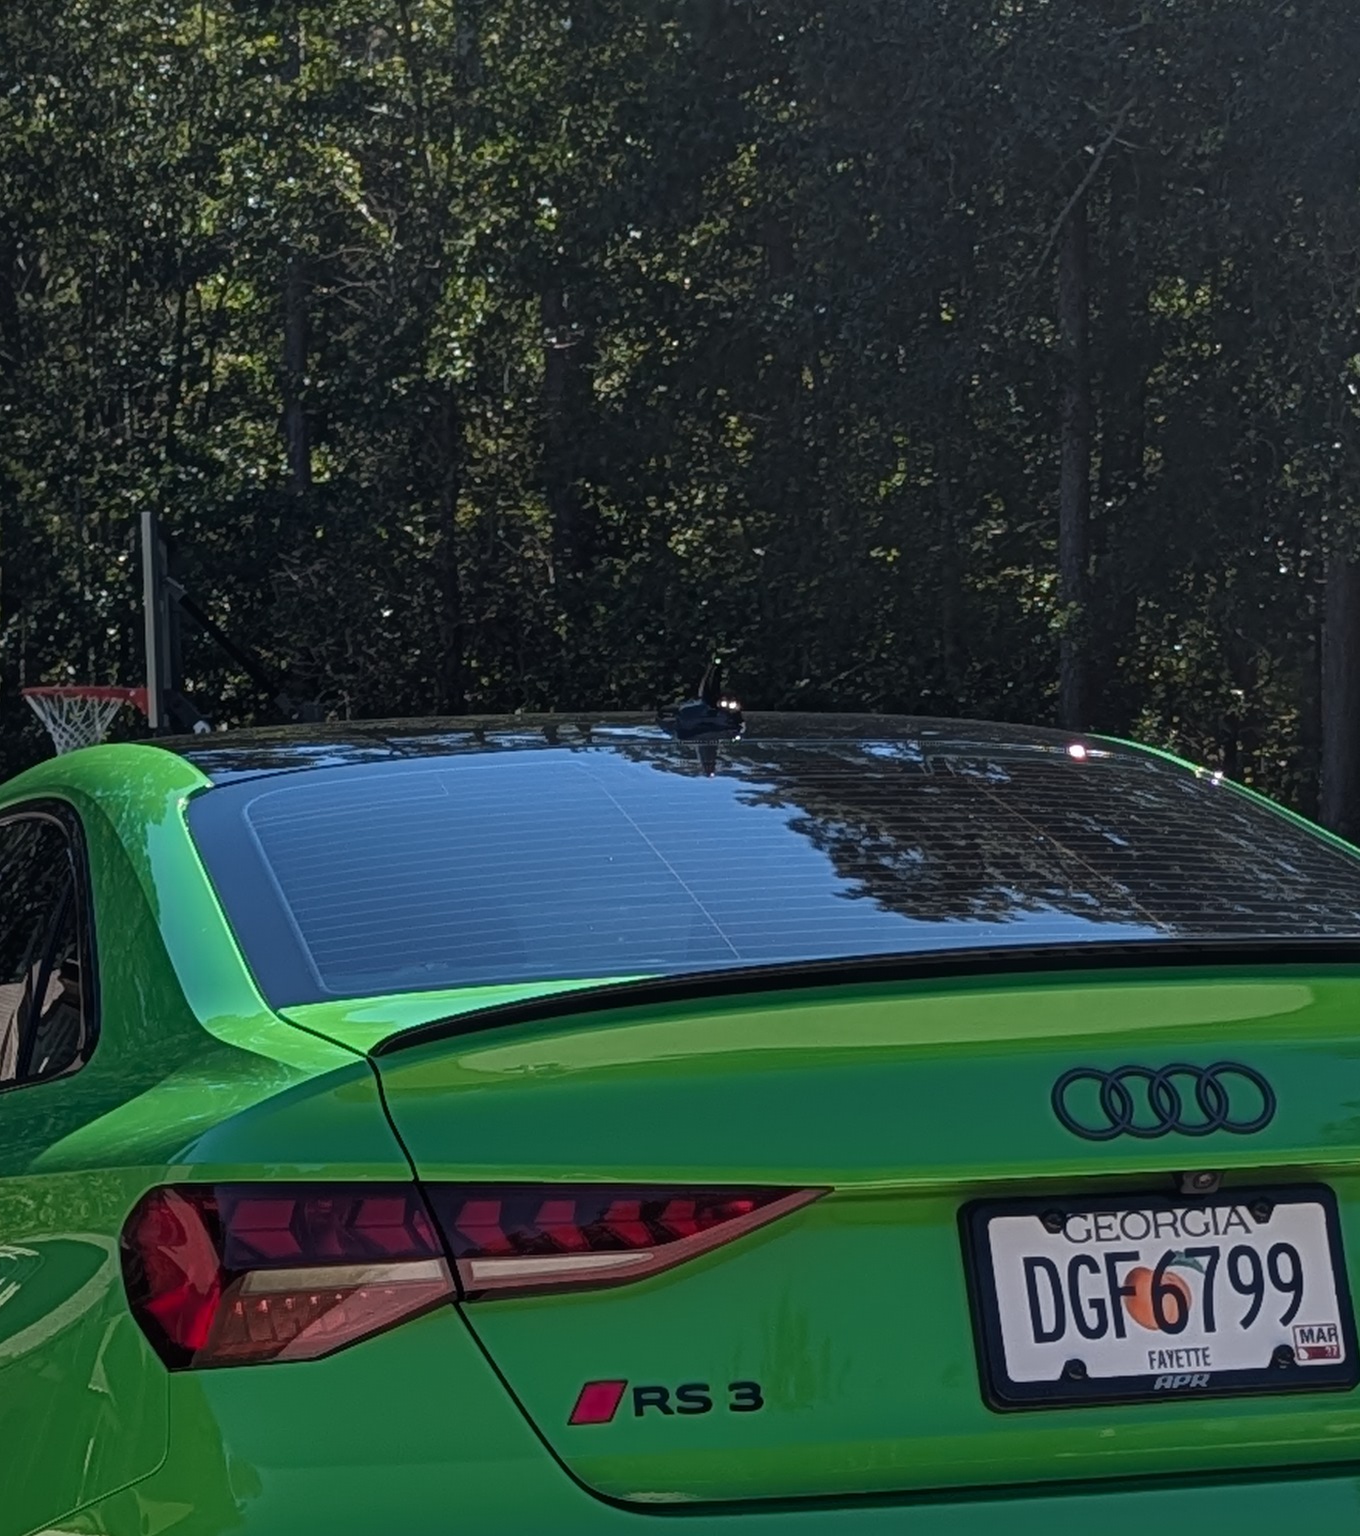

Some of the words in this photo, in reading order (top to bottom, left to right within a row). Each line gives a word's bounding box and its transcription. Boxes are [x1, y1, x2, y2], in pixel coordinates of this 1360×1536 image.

[1062, 1204, 1252, 1244] GEORGIA
[1022, 1242, 1304, 1344] DGF6799
[1299, 1327, 1338, 1344] MAR
[1148, 1346, 1212, 1370] FAYETTE
[1153, 1373, 1210, 1390] APR
[633, 1383, 714, 1417] RS
[728, 1381, 765, 1412] 3
